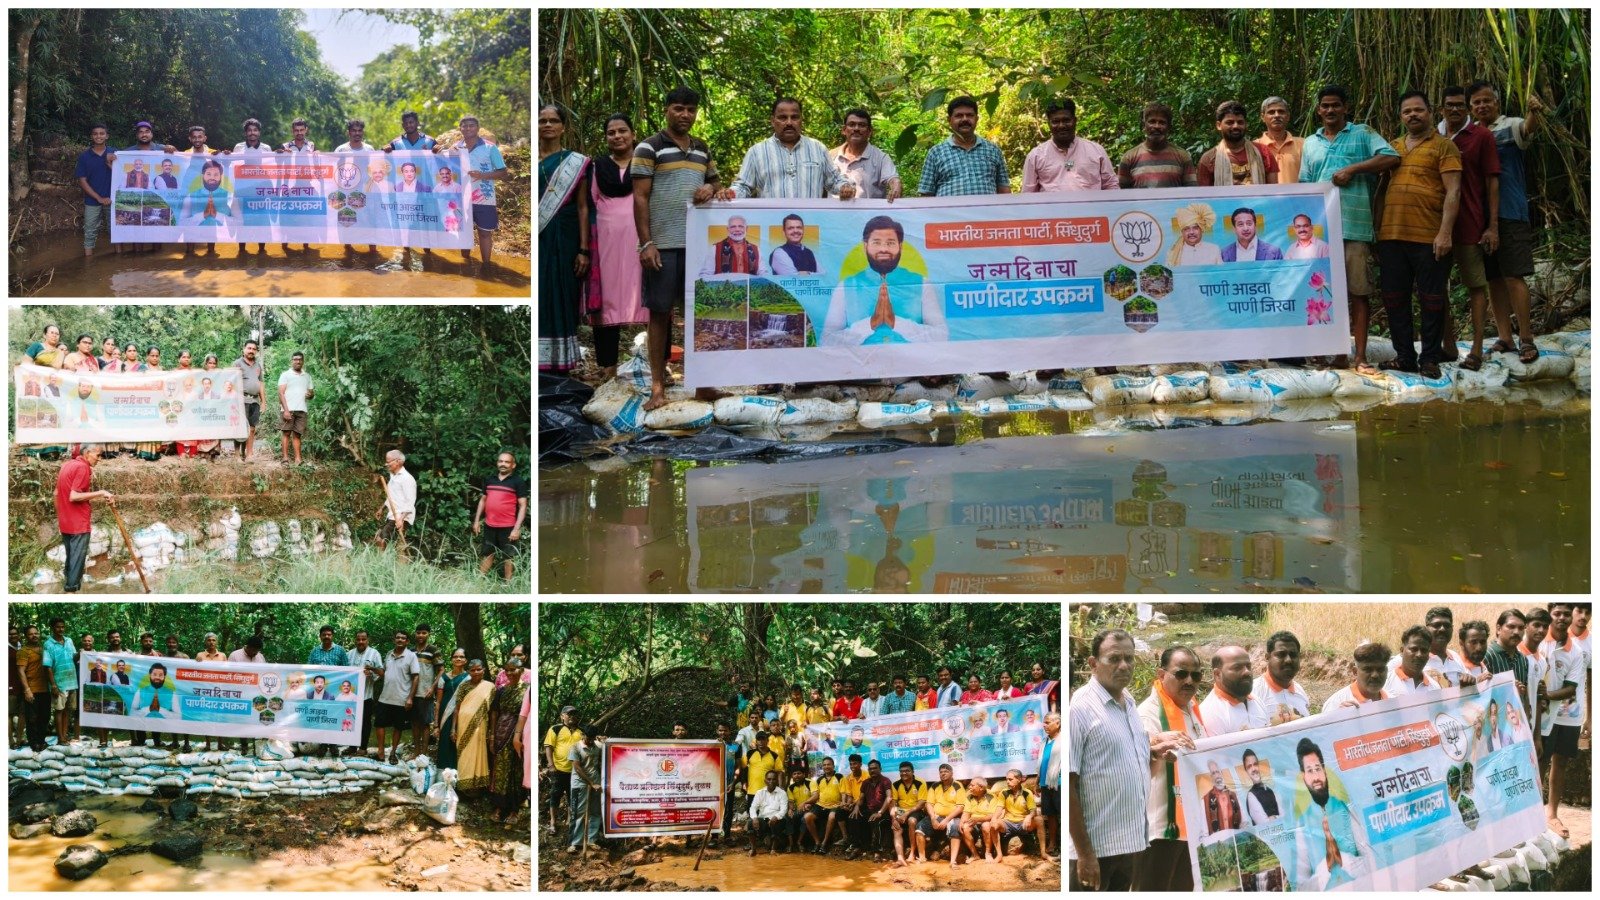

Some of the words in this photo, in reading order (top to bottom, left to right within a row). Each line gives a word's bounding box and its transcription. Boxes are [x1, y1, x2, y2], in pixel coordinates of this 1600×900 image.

[247, 198, 287, 211] पाणीदार
[288, 200, 323, 211] उपक्रम
[380, 201, 398, 211] पाणी
[399, 203, 424, 212] आडवा
[396, 212, 415, 222] पाणी
[938, 225, 984, 243] भारतीय
[984, 226, 1022, 241] जनता
[1055, 220, 1101, 243] सिंधुदुर्ग
[952, 282, 1029, 310] पाणीदार
[1030, 284, 1095, 307] उपक्रम
[1199, 280, 1230, 297] पाणी
[1232, 282, 1271, 296] आडवा
[1227, 296, 1258, 314] पाणी
[1259, 296, 1296, 313] जिरवा
[185, 697, 218, 709] पाणीदार
[219, 701, 249, 711] उपक्रम
[881, 748, 909, 760] पाणीदार
[910, 747, 937, 758] उपक्रम
[1343, 739, 1372, 761] भारतीय
[1369, 738, 1392, 755] जनता
[1368, 801, 1412, 833] पाणीदार
[1411, 789, 1446, 818] उपक्रम
